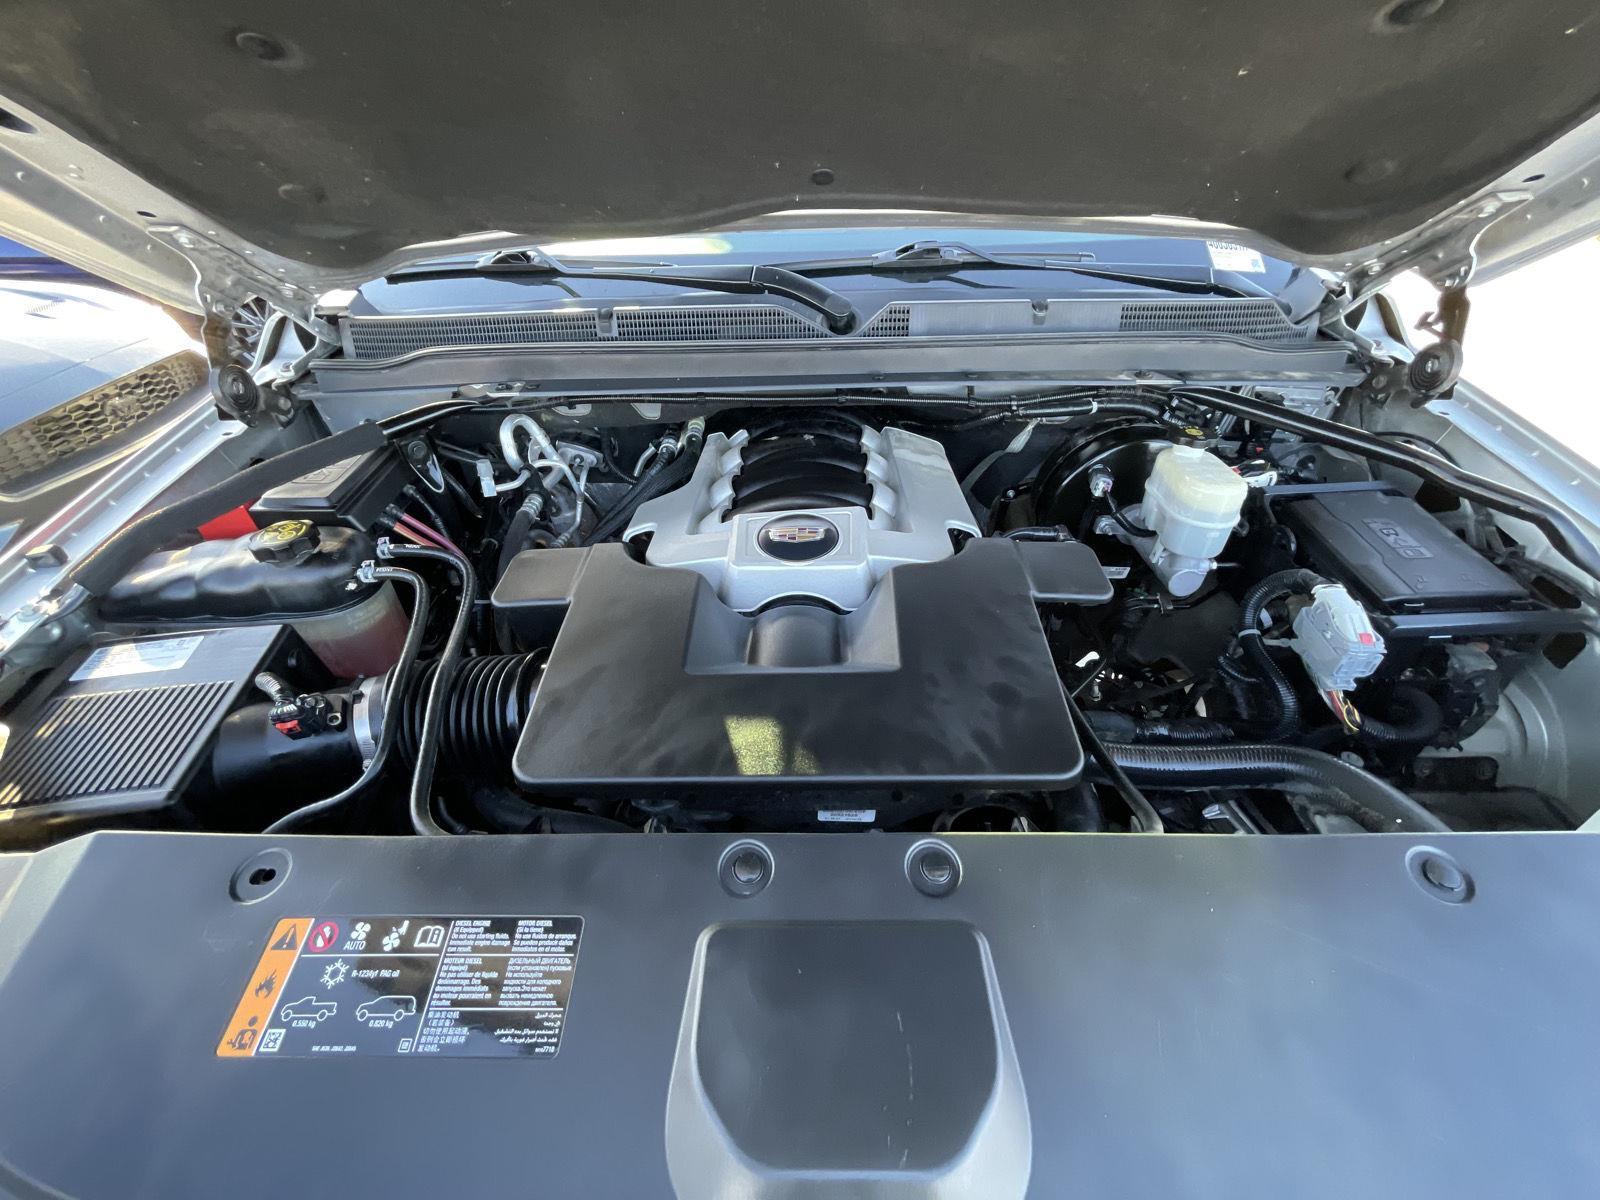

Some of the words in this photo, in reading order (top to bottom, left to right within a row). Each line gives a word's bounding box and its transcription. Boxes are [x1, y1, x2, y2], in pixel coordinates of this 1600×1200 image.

[343, 941, 366, 950] AUTO
[307, 1020, 316, 1028] kg
[385, 1020, 393, 1028] kg
